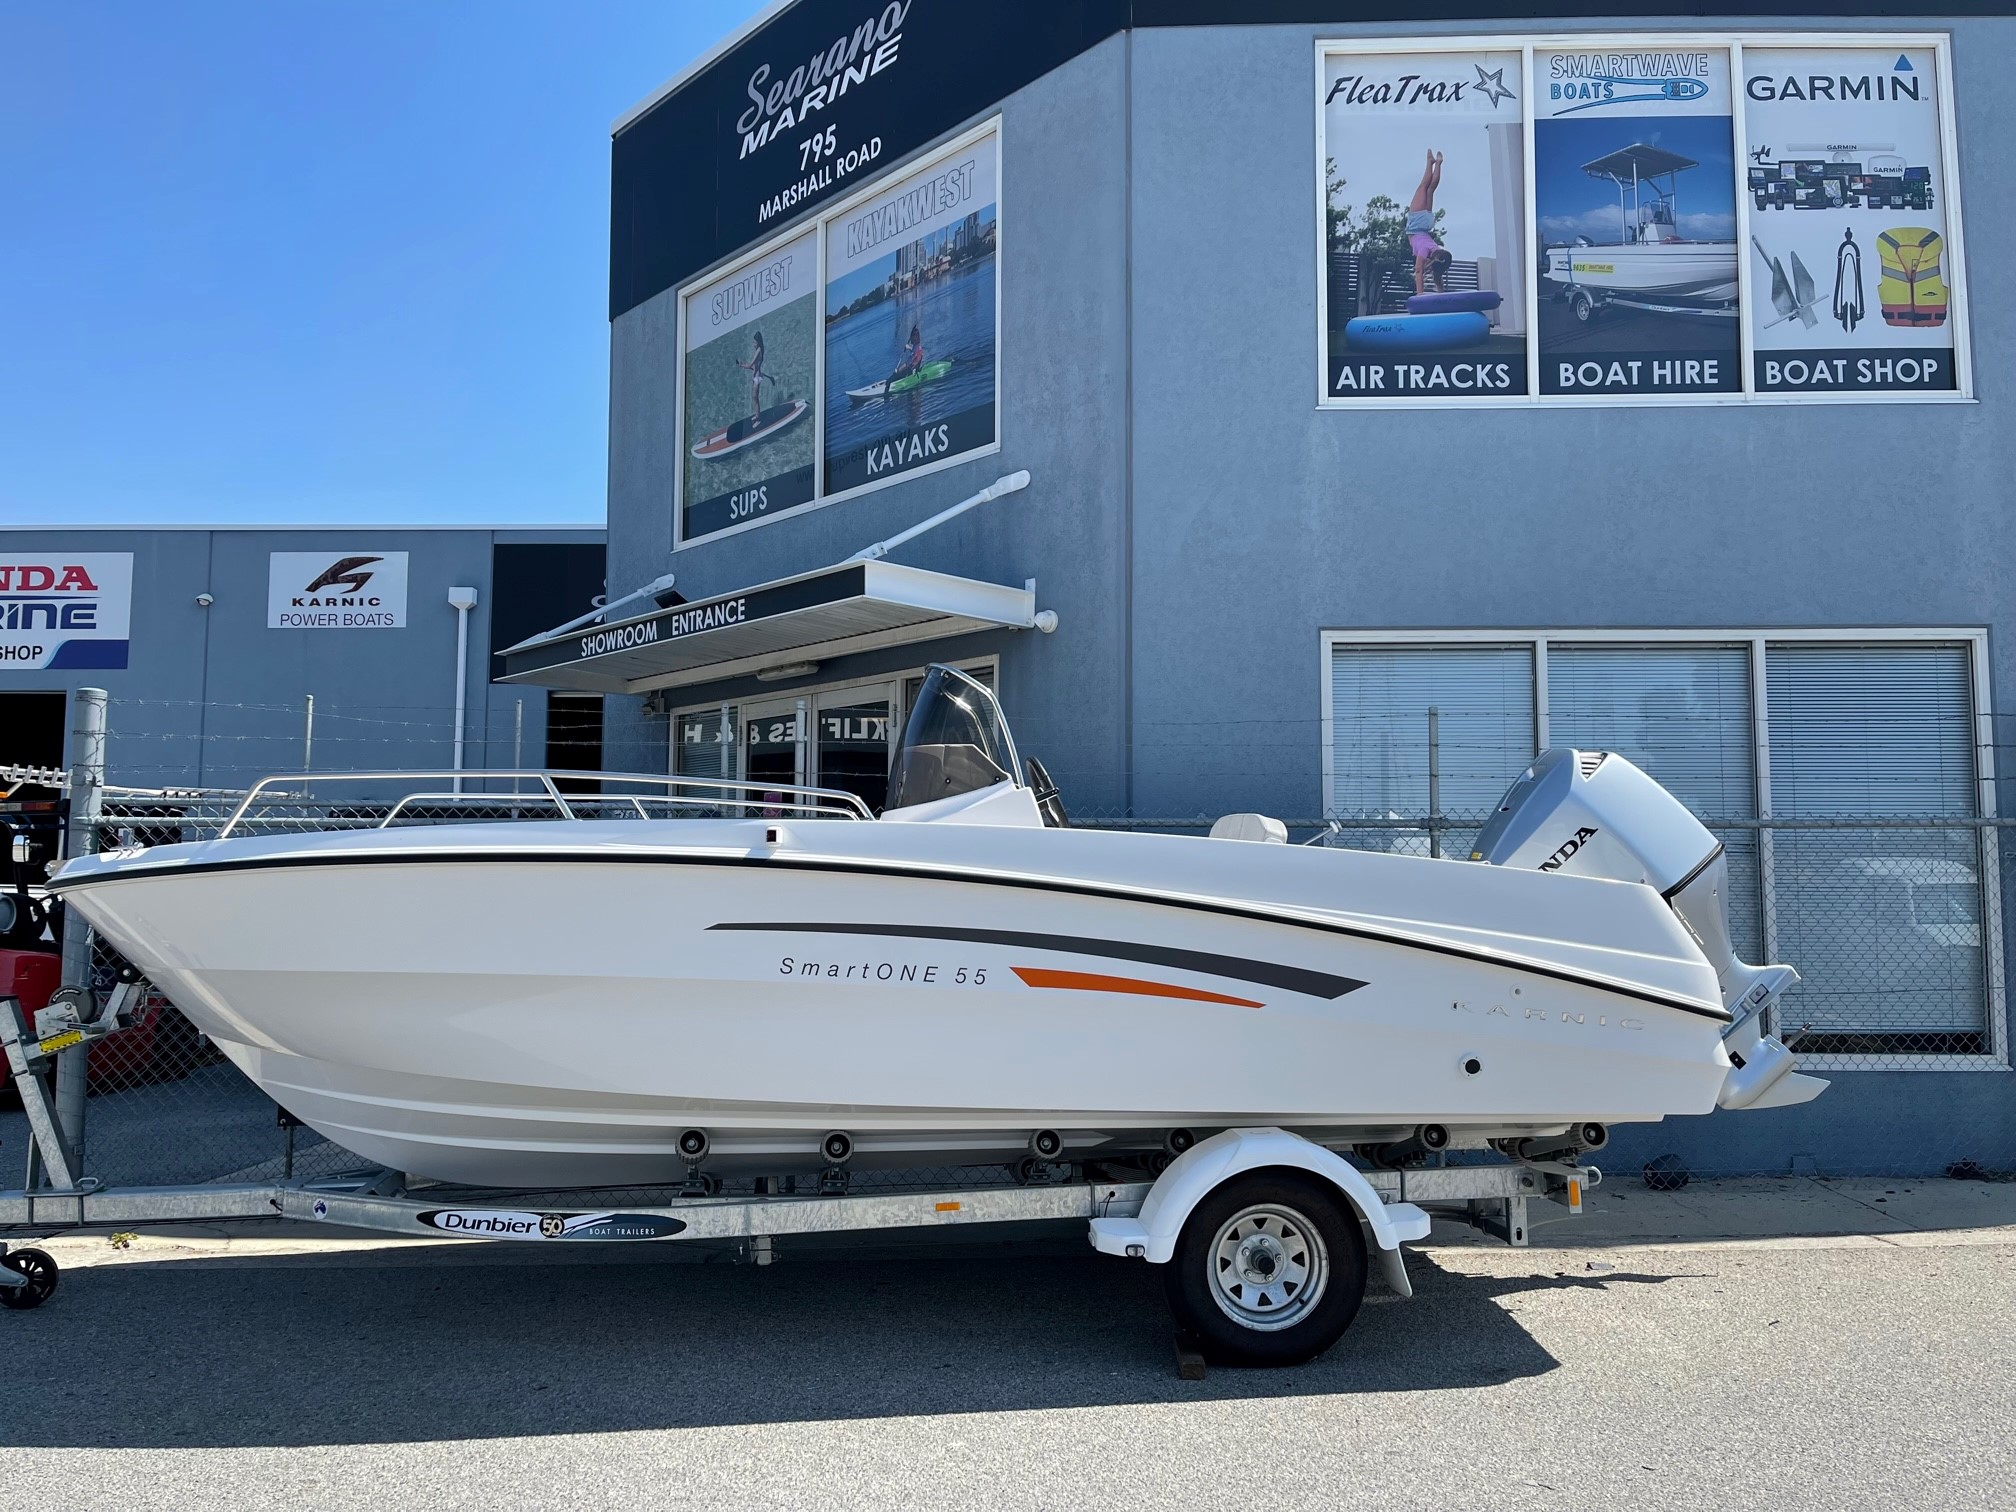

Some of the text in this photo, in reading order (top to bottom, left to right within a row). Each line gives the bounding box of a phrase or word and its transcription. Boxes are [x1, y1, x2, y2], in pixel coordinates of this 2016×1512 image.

[737, 0, 912, 134] Searano
[1550, 53, 1709, 78] SMARTWAVE
[739, 33, 902, 159] MARINE
[1325, 74, 1469, 105] FleaTrax
[1550, 82, 1614, 100] BOATS
[1746, 75, 1919, 101] GARMIN
[800, 124, 837, 170] 795
[759, 137, 882, 223] MARSHALL ROAD
[847, 160, 976, 258] KAYAKWEST
[711, 255, 793, 326] SUPWEST
[1335, 363, 1511, 390] AIR TRACKS
[1559, 359, 1719, 387] BOAT HIRE
[1765, 358, 1938, 385] BOAT SHOP
[867, 424, 949, 475] KAYAKS
[729, 485, 768, 520] SUPS
[0, 603, 97, 630] INE
[292, 597, 381, 607] KARNIC
[280, 613, 394, 627] POWER BOATS
[581, 598, 746, 658] SHOWROOM ENTRANCE
[1538, 825, 1599, 873] NDA
[779, 957, 987, 985] SmartONE 55
[1452, 1000, 1645, 1031] KARNIC
[445, 1213, 537, 1234] Dunbier
